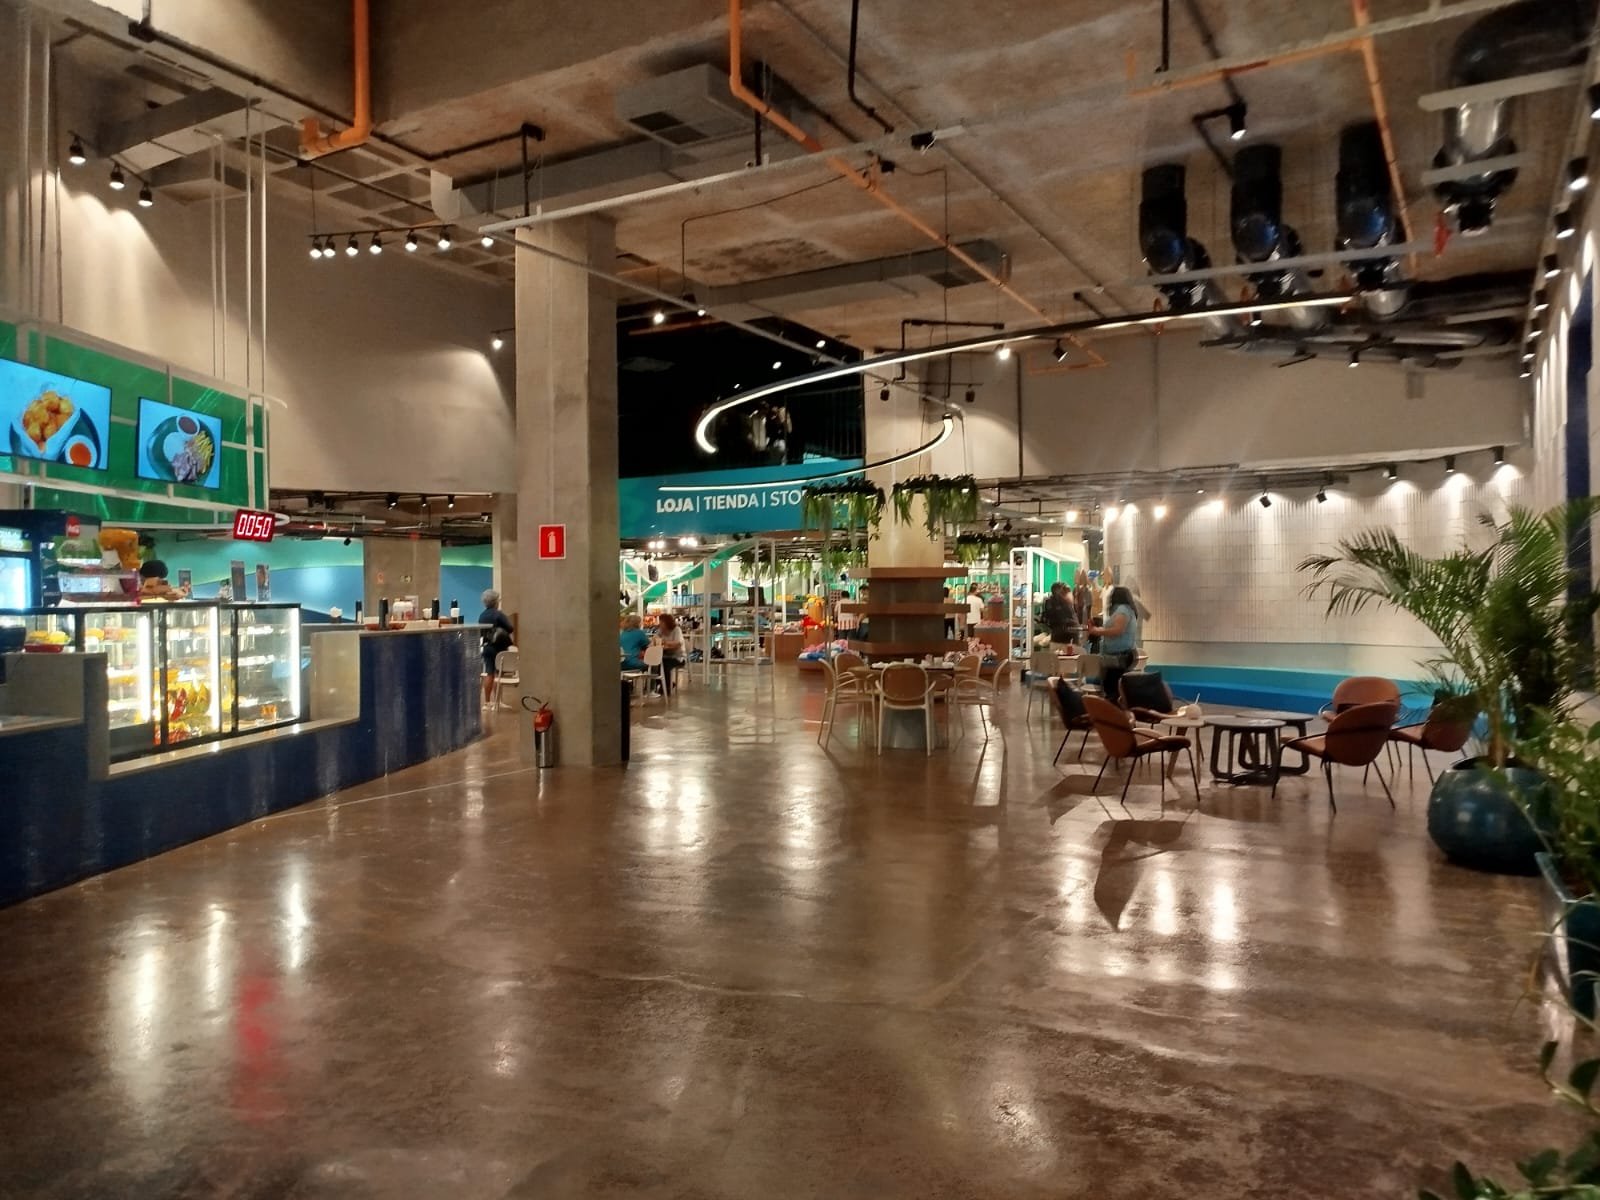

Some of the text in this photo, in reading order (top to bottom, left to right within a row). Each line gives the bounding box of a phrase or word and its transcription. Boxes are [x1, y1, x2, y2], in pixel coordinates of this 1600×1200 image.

[656, 498, 695, 513] LOJA
[704, 494, 759, 510] TIENDA
[236, 514, 272, 538] 0050
